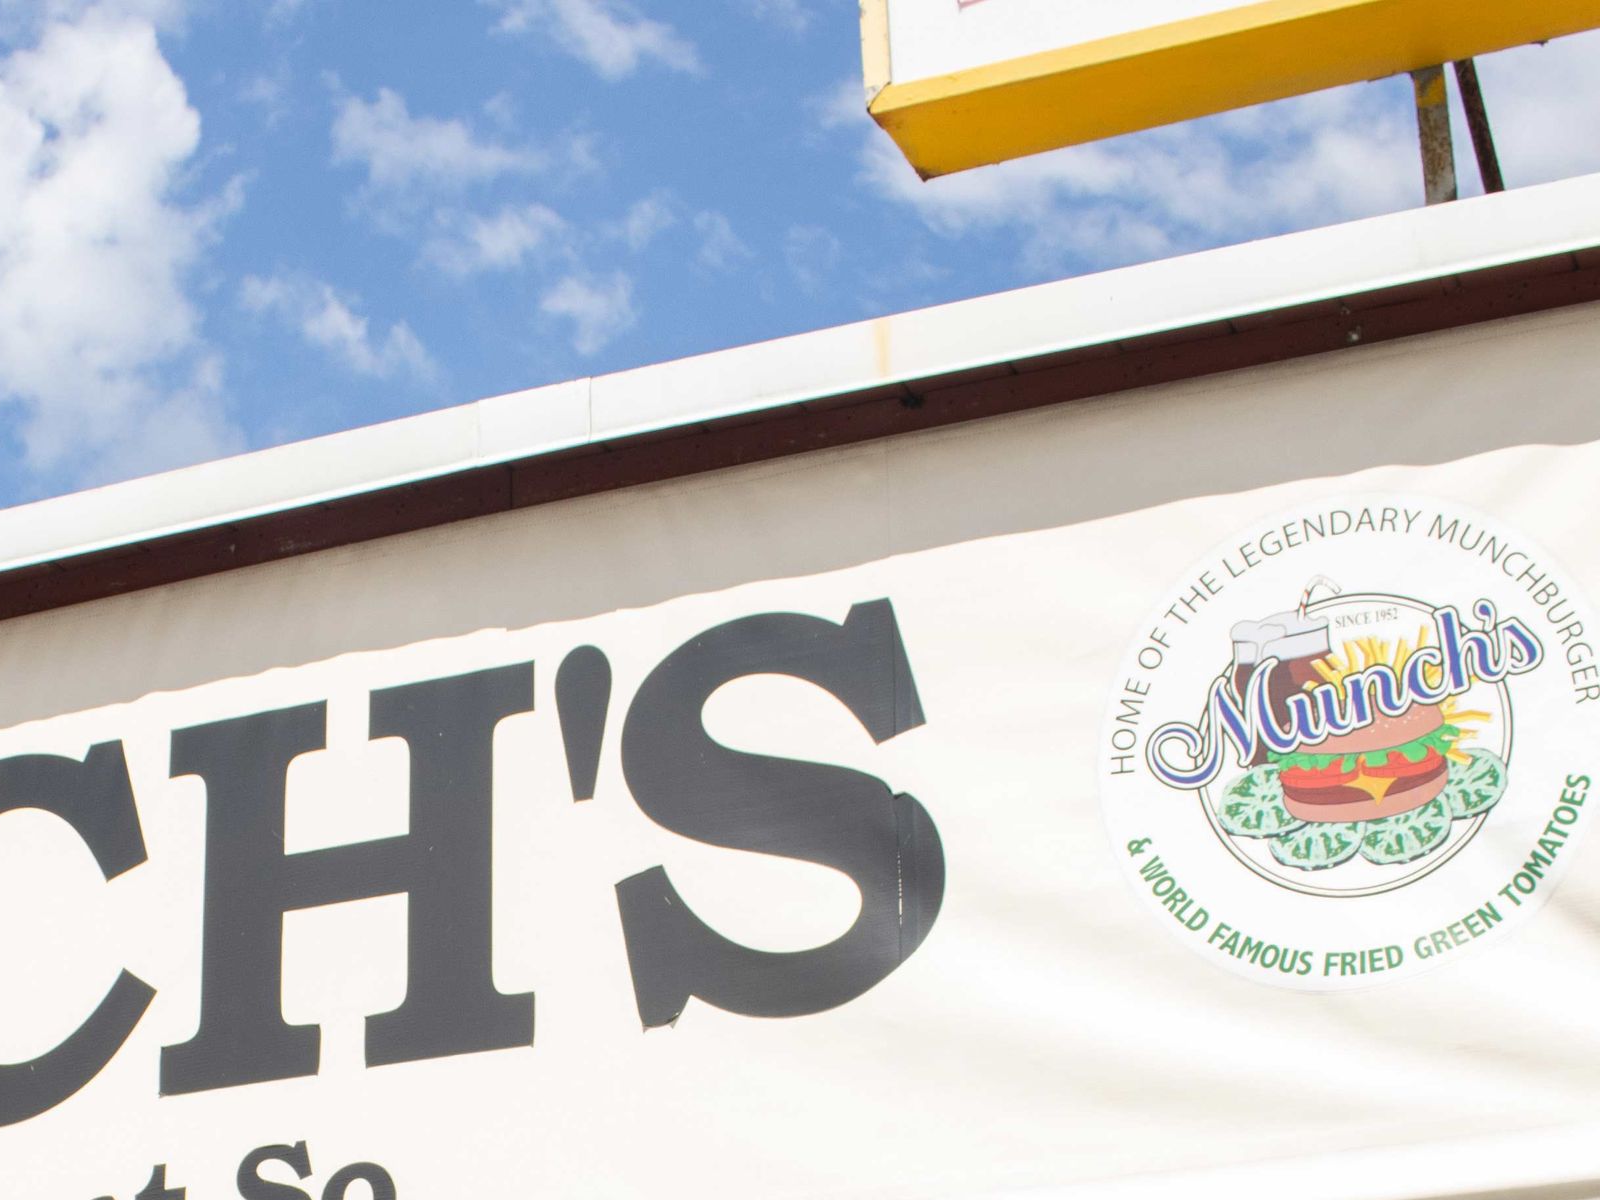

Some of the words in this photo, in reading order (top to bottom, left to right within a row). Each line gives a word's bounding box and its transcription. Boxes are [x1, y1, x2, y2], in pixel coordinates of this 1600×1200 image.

[1110, 680, 1152, 776] HOME
[1138, 626, 1172, 671] OF
[1164, 571, 1224, 627] THE
[1222, 507, 1422, 579] LEGENDARY
[1428, 513, 1600, 706] MUNCHBURGER
[1334, 611, 1370, 630] SINCE
[1372, 606, 1399, 625] 1952
[1146, 598, 1544, 791] Munch's
[1126, 836, 1154, 860] &
[1497, 772, 1592, 909] TOMATOES
[1138, 855, 1210, 934] WORLD
[1207, 922, 1313, 977] FAMOUS
[1323, 944, 1404, 978] FRIED
[1414, 902, 1504, 961] GREEN
